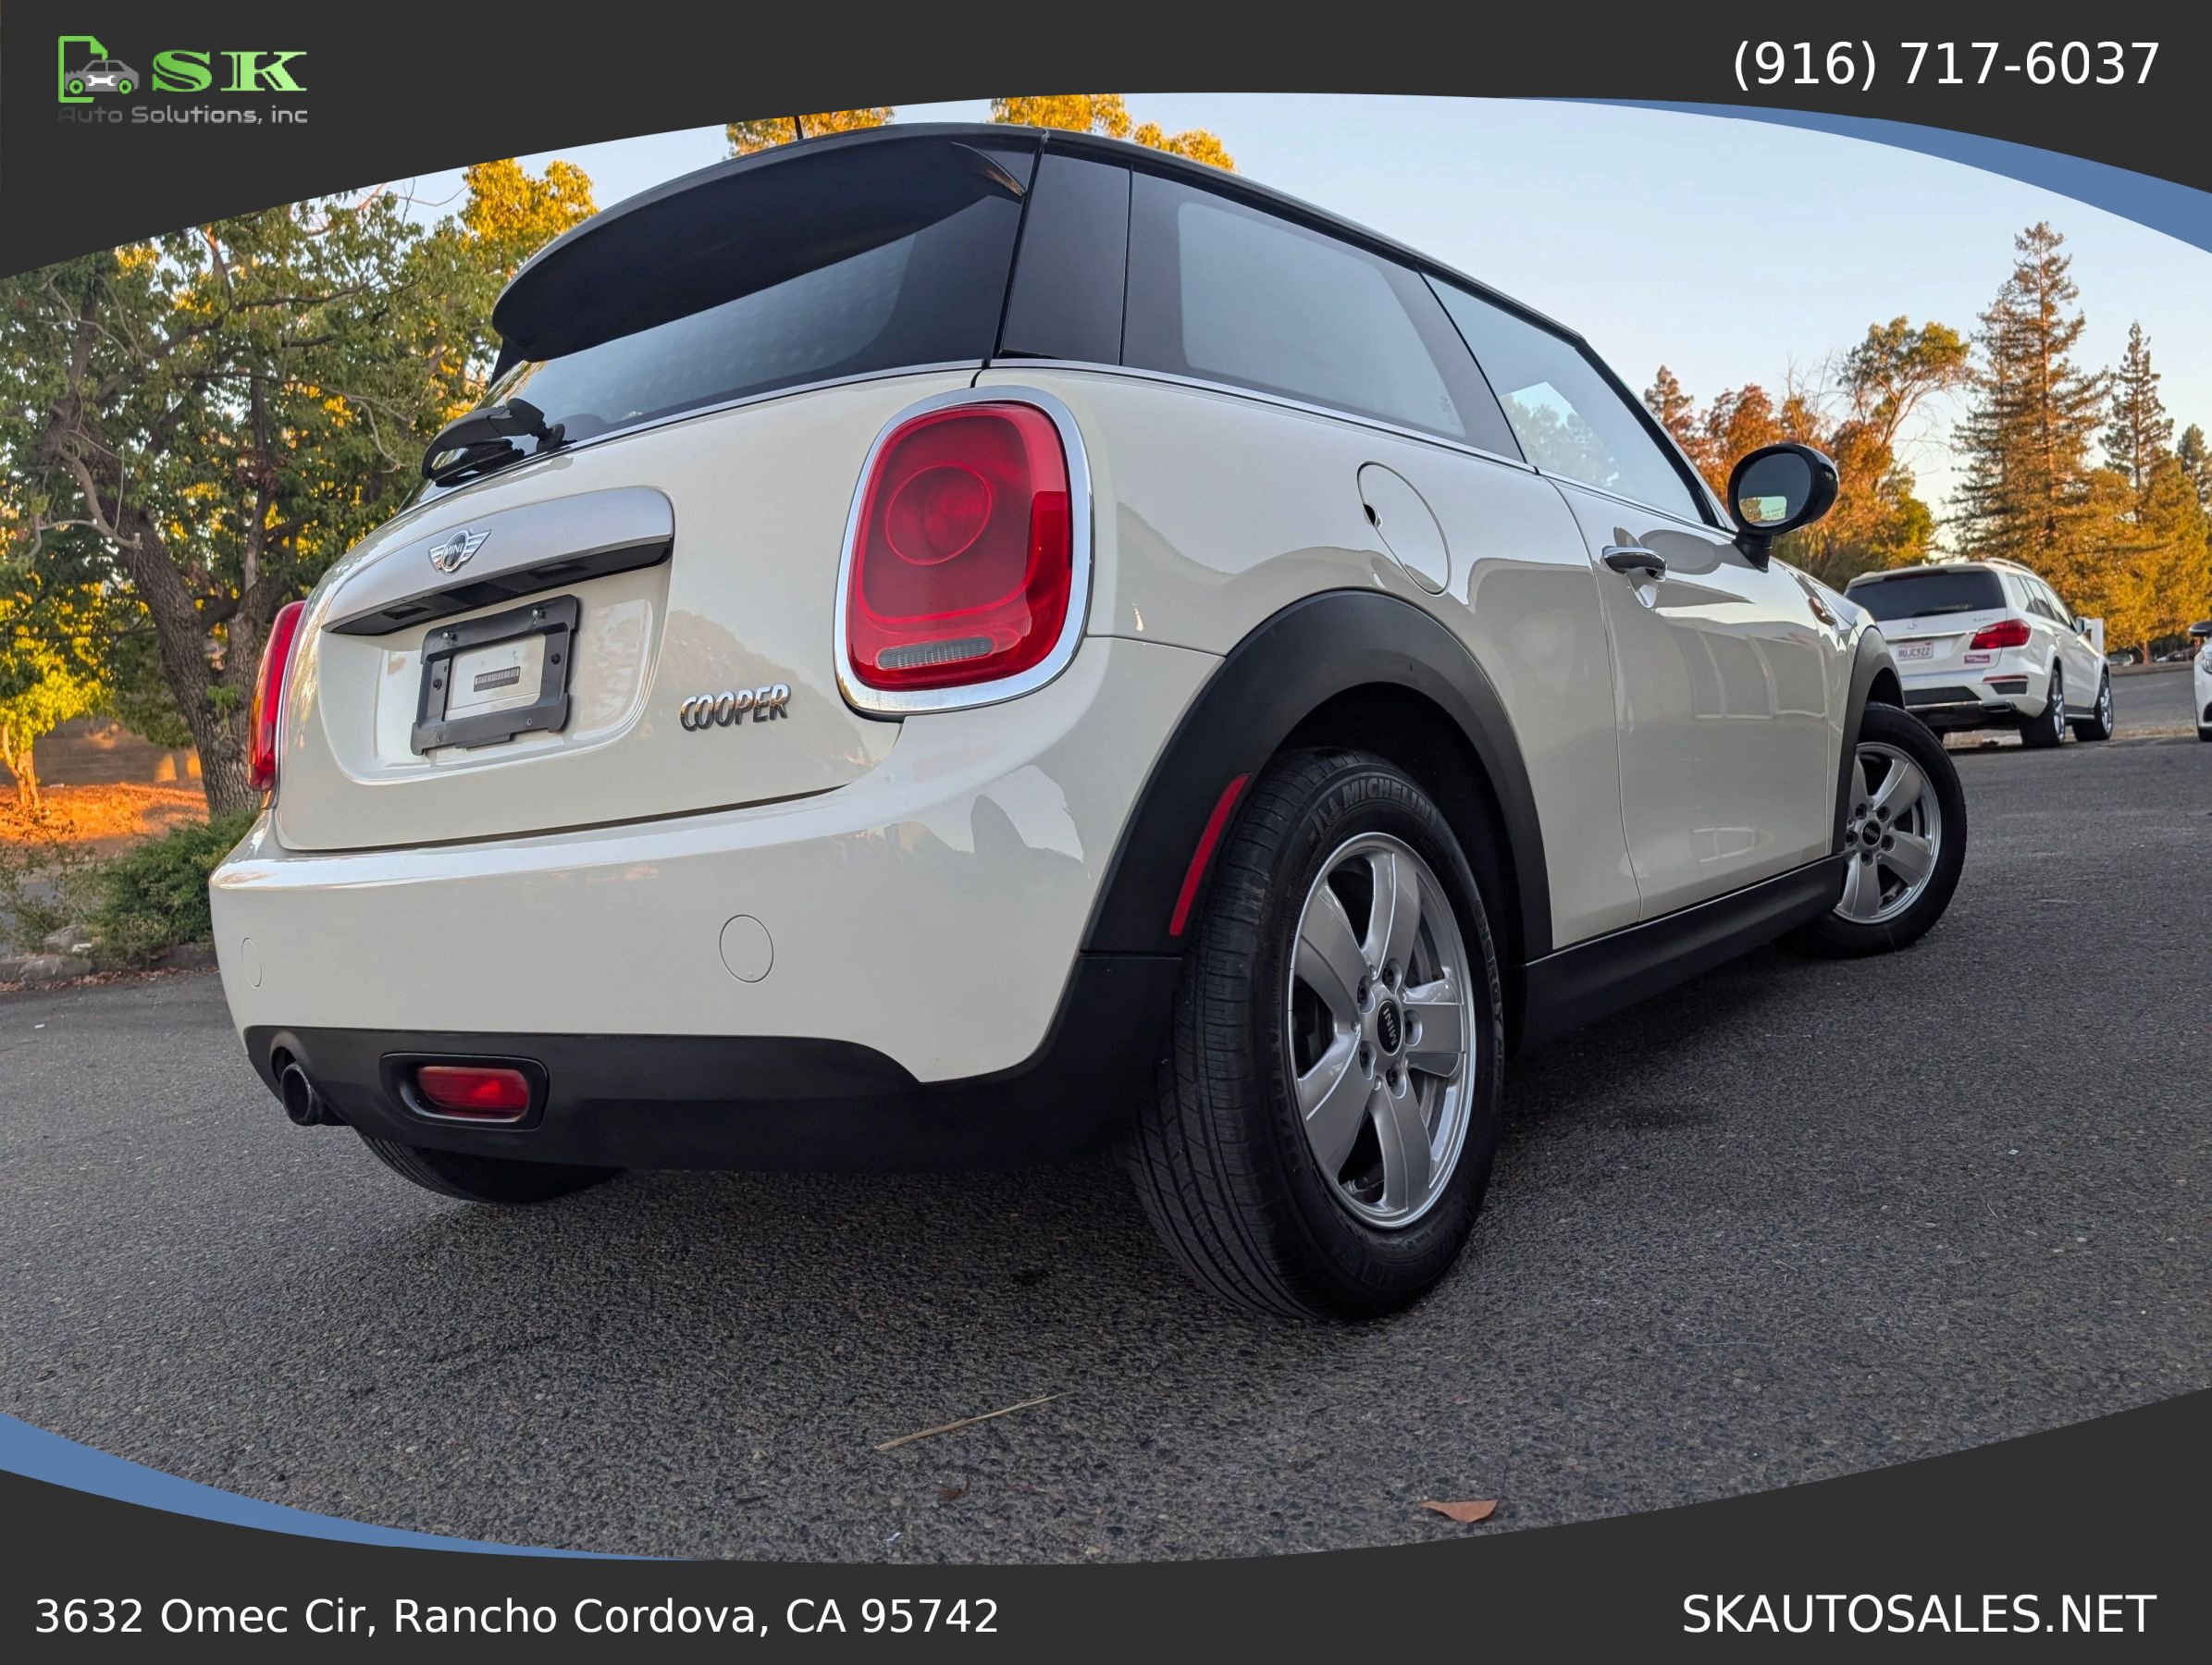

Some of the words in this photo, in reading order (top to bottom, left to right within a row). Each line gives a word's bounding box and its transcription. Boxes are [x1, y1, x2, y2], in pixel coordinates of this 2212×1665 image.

[446, 542, 463, 556] MINI
[680, 683, 792, 732] COOPER
[1341, 778, 1435, 822] MICHELIN
[1383, 1008, 1398, 1046] MINI
